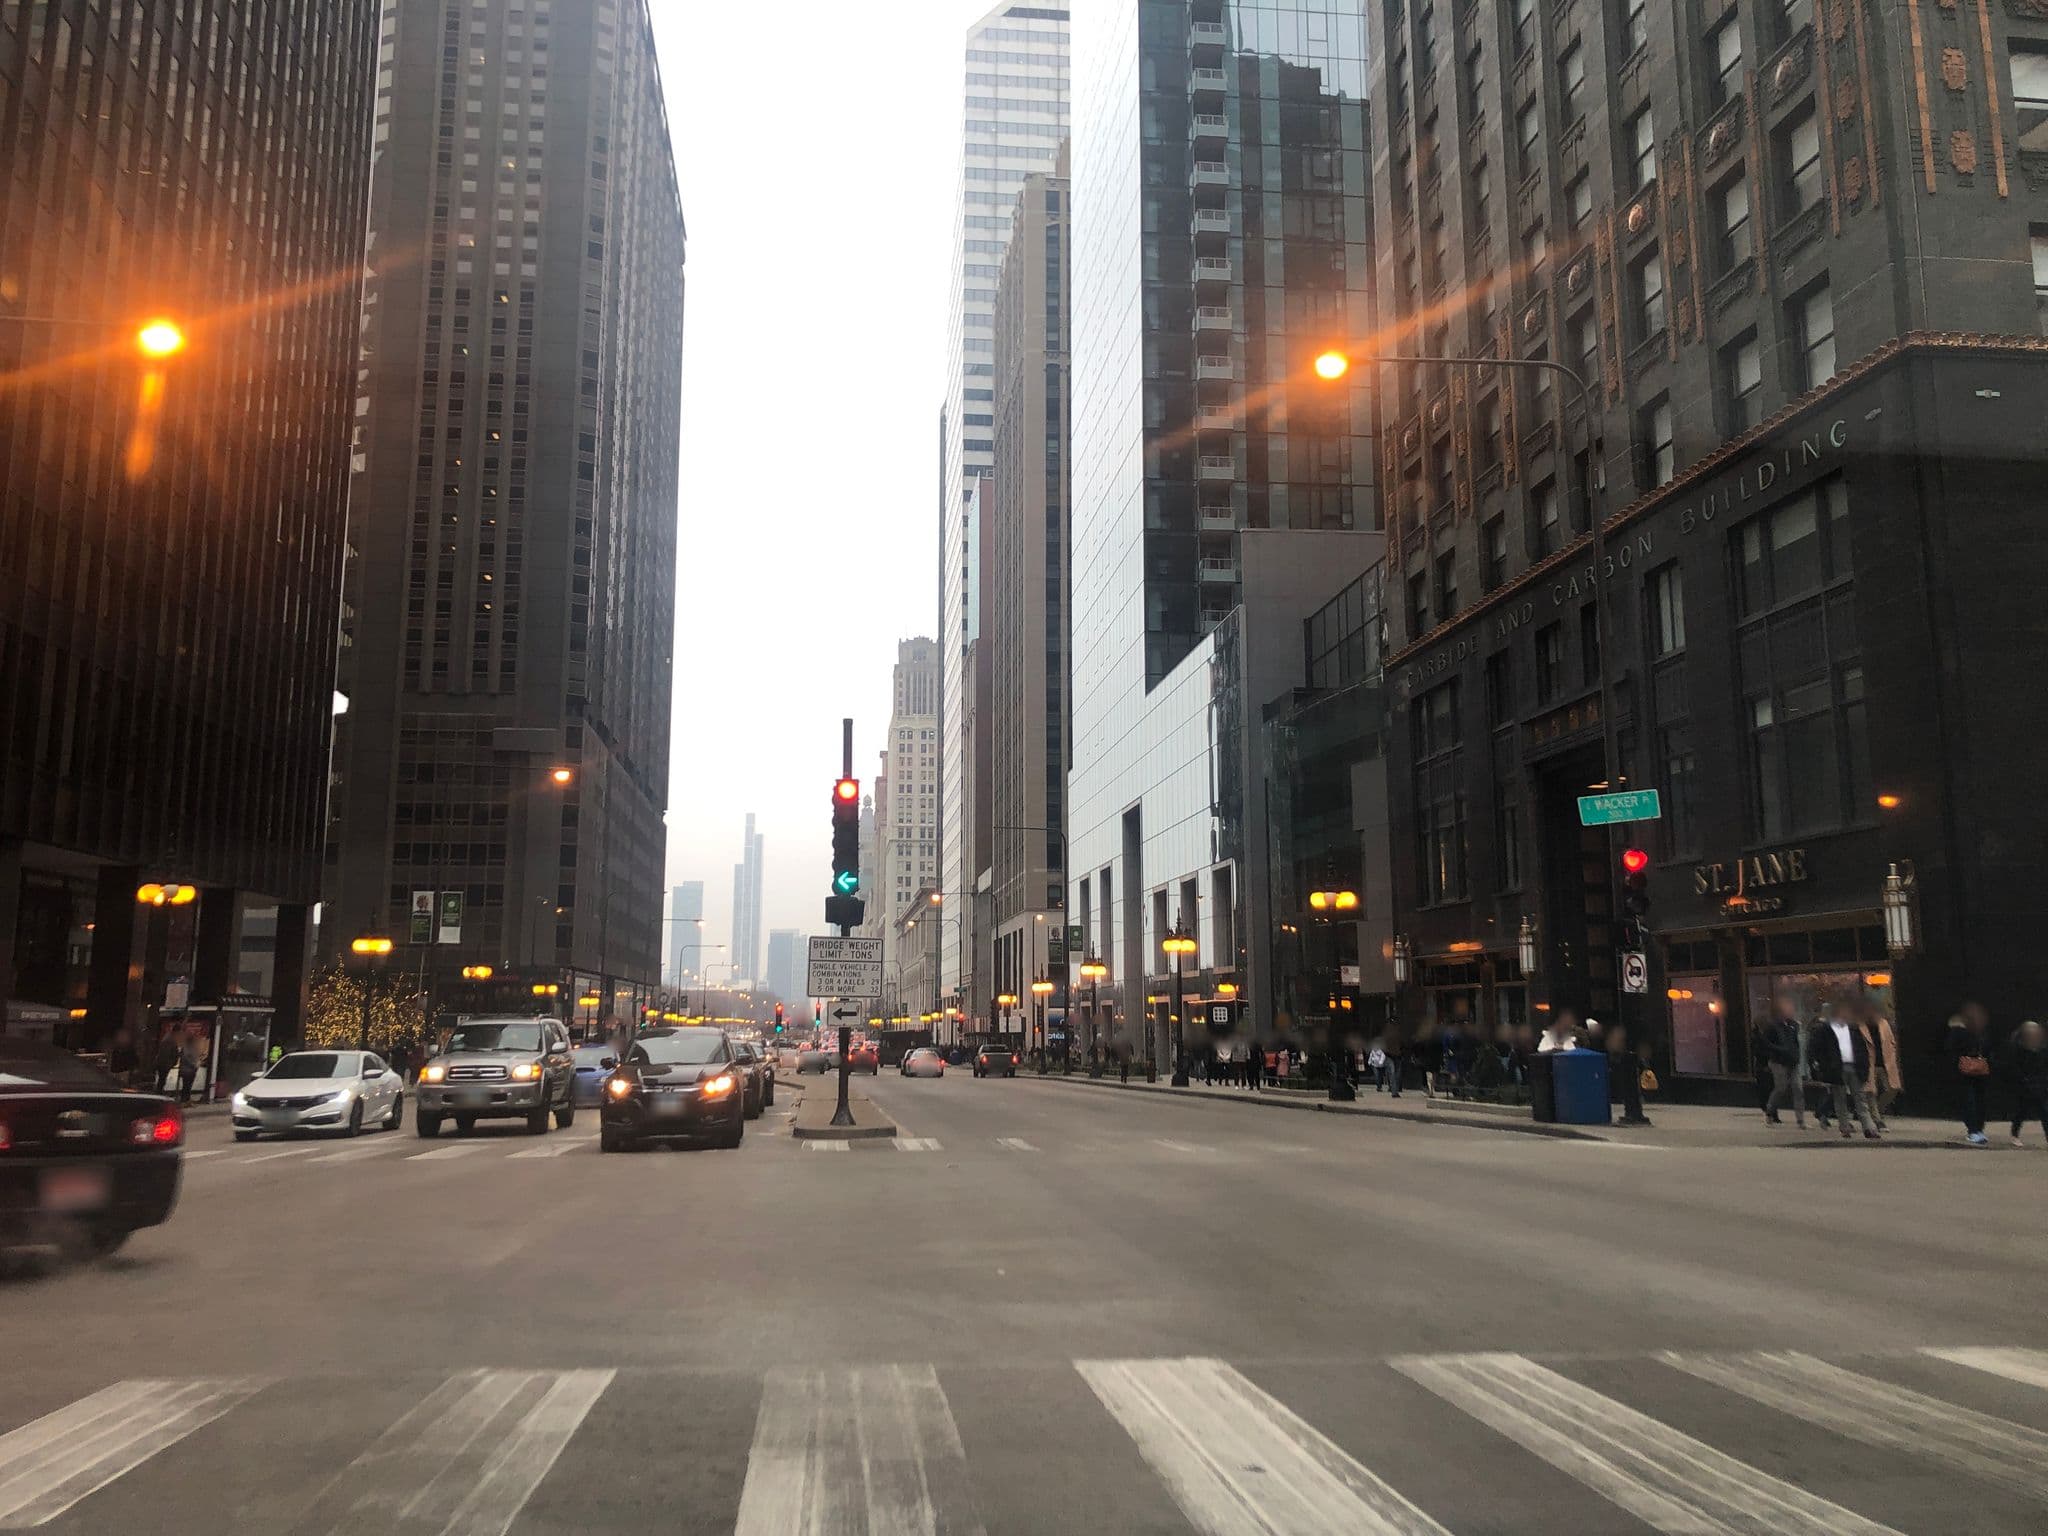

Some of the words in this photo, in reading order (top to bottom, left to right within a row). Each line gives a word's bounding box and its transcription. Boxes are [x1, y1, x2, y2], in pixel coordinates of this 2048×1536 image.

[1407, 633, 1479, 689] CARBIDE
[1496, 602, 1534, 640] AND
[1552, 532, 1652, 606] CARBON
[1680, 419, 1847, 535] BUILDING
[1594, 796, 1638, 811] WACKER
[1694, 863, 1731, 895] ST.
[1732, 849, 1808, 897] JANE
[813, 941, 844, 950] BRIDGE
[849, 942, 880, 951] WEIGHT
[820, 951, 842, 959] LIMIT
[851, 951, 873, 960] TONS
[840, 963, 868, 971] VEHICLE
[844, 978, 865, 986] AXLES
